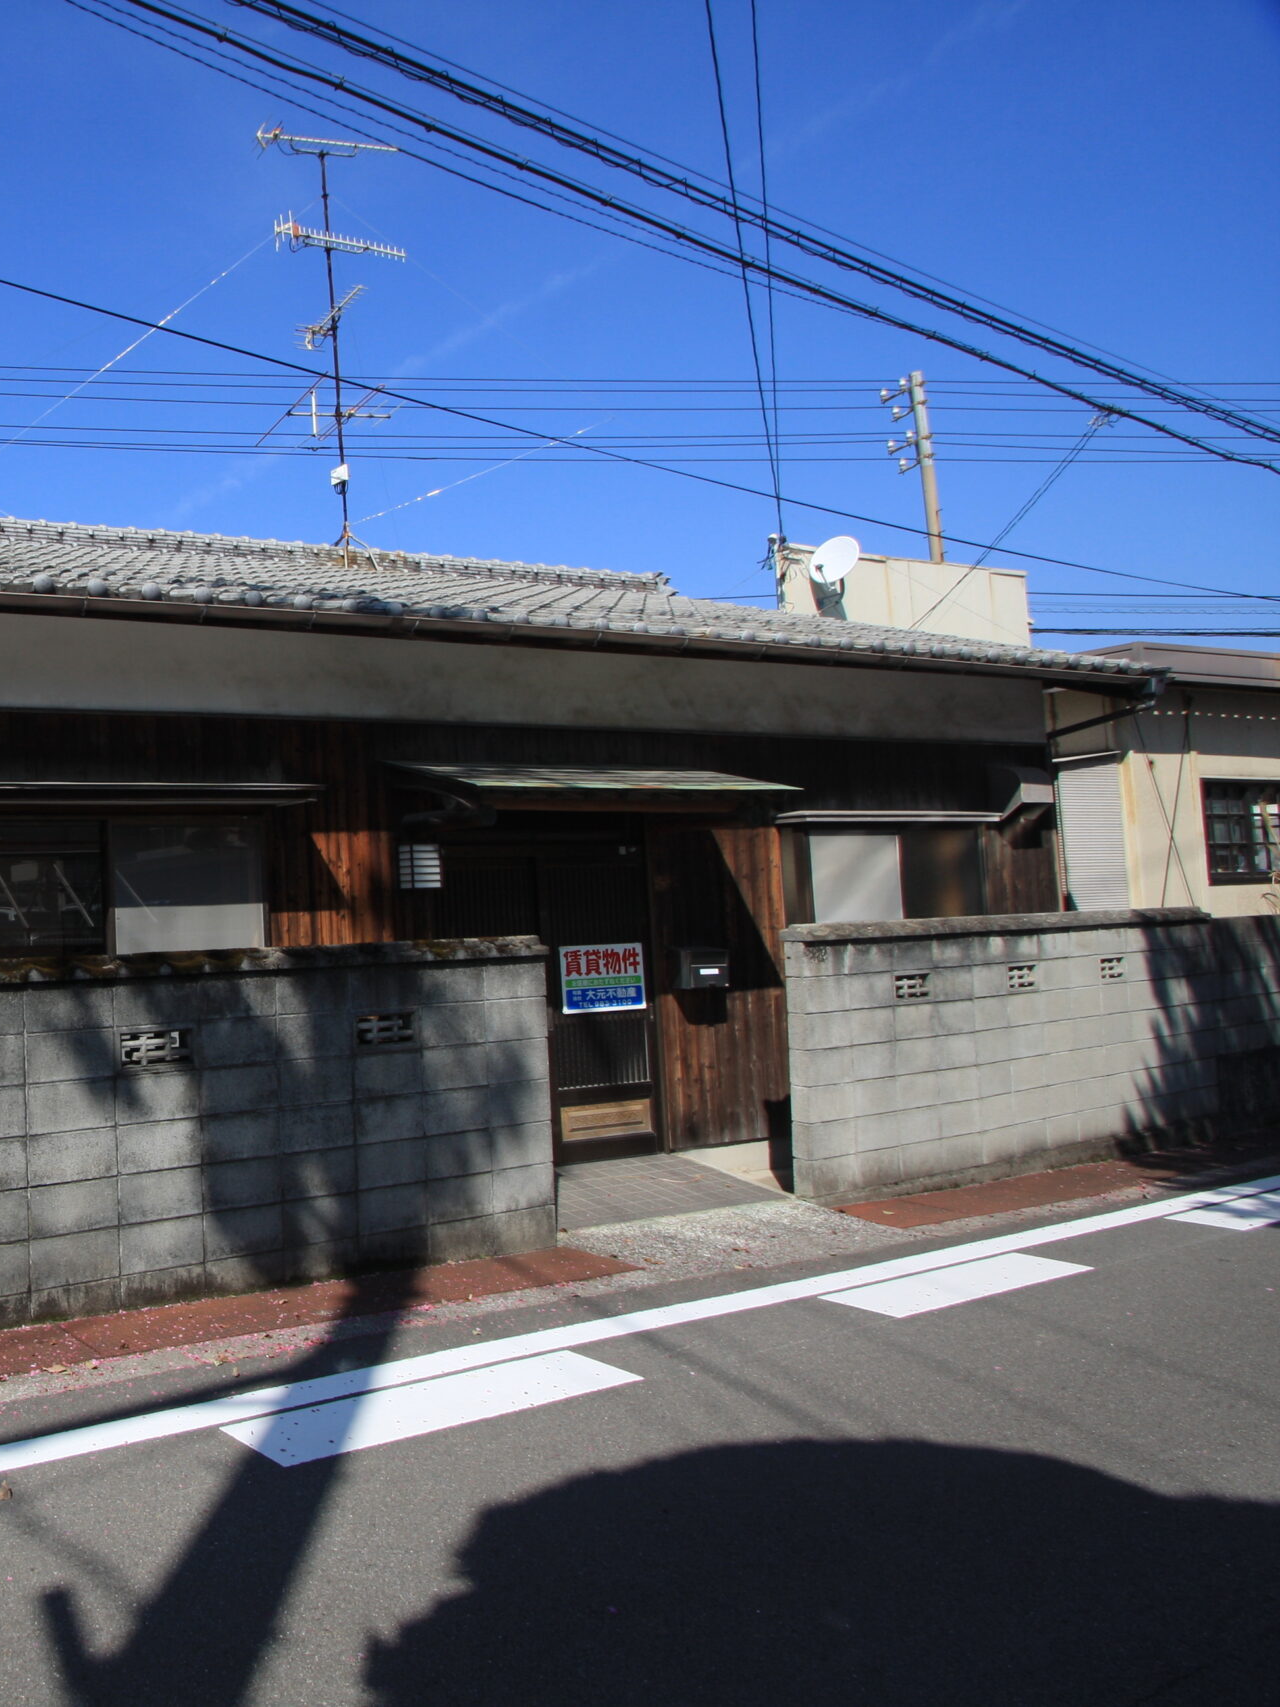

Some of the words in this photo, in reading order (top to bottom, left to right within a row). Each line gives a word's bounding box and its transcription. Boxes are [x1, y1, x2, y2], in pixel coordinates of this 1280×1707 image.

[563, 947, 640, 977] 賃貸物件
[585, 987, 637, 1000] 大元不動産
